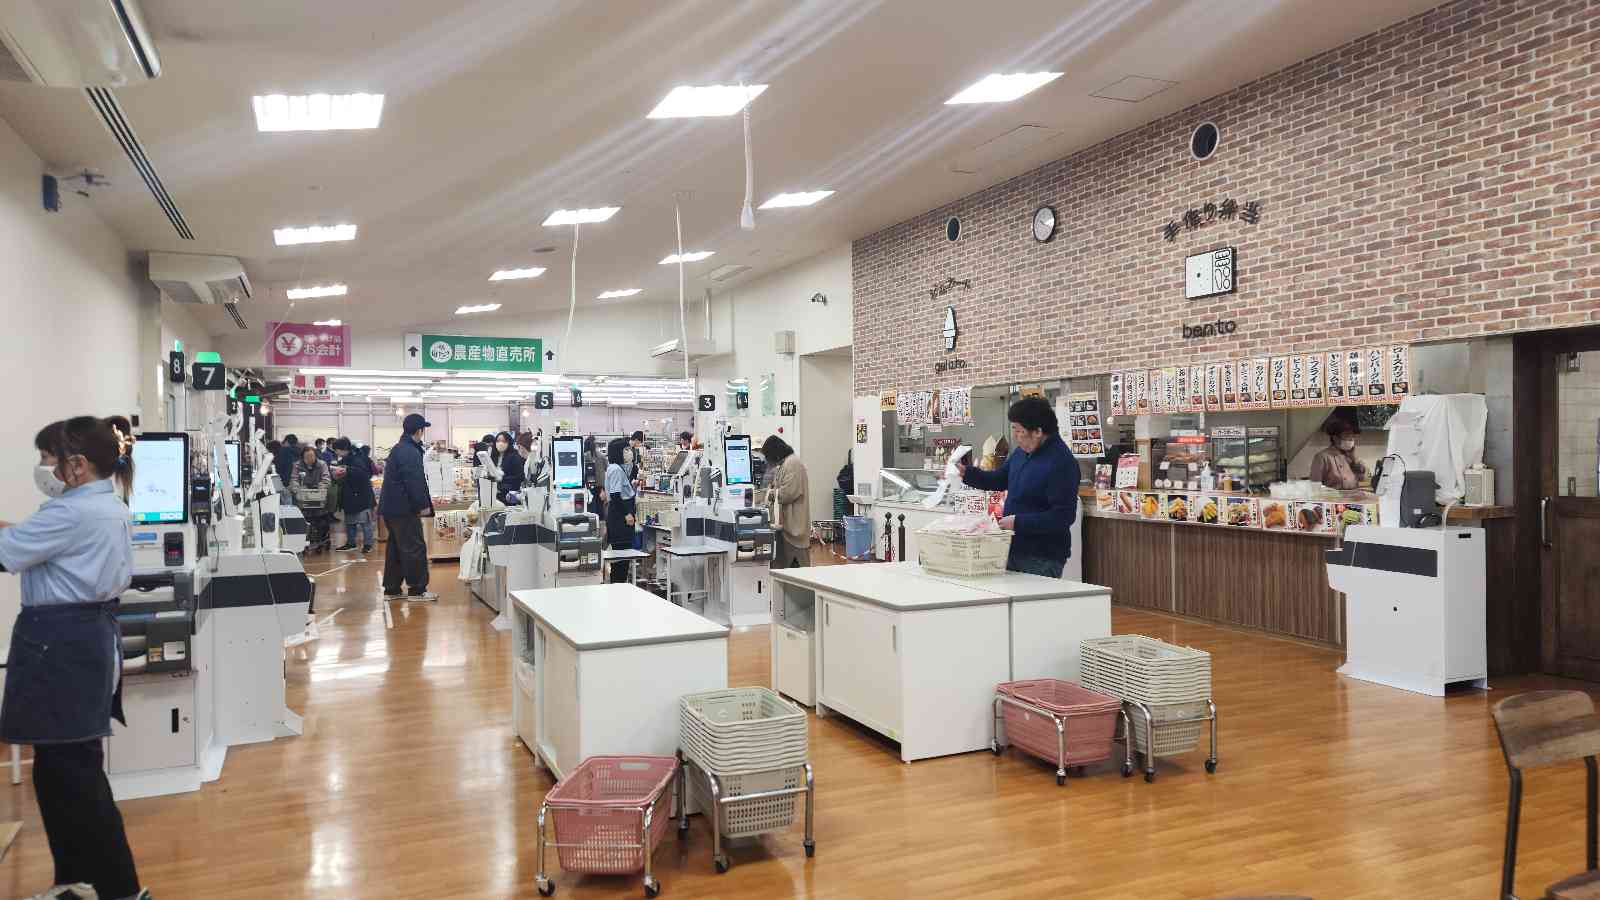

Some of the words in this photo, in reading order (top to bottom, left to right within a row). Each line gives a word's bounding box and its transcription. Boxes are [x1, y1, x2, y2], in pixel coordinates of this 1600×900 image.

[1163, 198, 1260, 241] 手作り弁当
[1182, 319, 1237, 339] bento
[303, 344, 342, 357] お会計
[453, 344, 536, 363] 農産物直売所
[173, 360, 181, 374] 8
[935, 358, 966, 374] gelato
[201, 368, 216, 386] 7
[541, 395, 549, 407] 5
[704, 398, 712, 409] 3
[249, 404, 255, 415] 1
